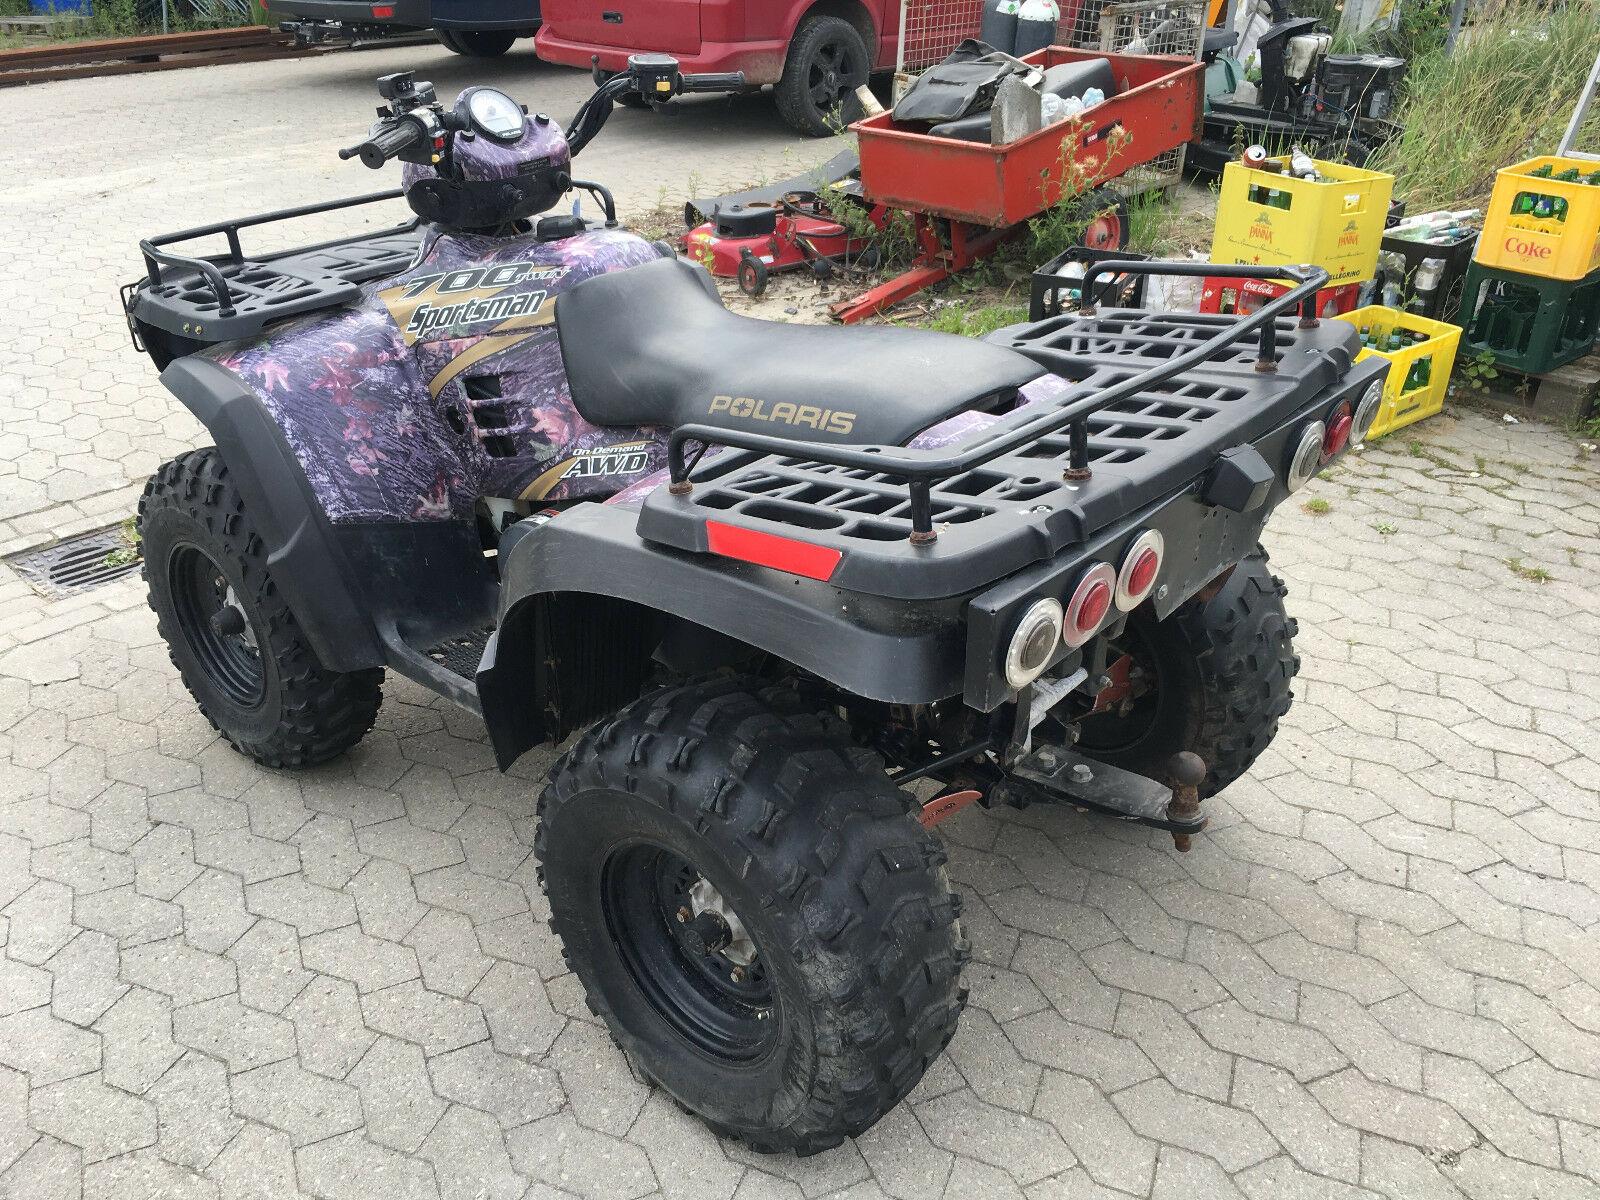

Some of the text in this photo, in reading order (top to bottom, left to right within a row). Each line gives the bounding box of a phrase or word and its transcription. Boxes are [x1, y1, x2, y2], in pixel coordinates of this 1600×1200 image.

[1504, 237, 1552, 259] Coke
[396, 262, 535, 301] 700
[406, 289, 547, 339] Sportsman
[707, 394, 857, 435] POLARIS
[560, 452, 648, 479] AWD
